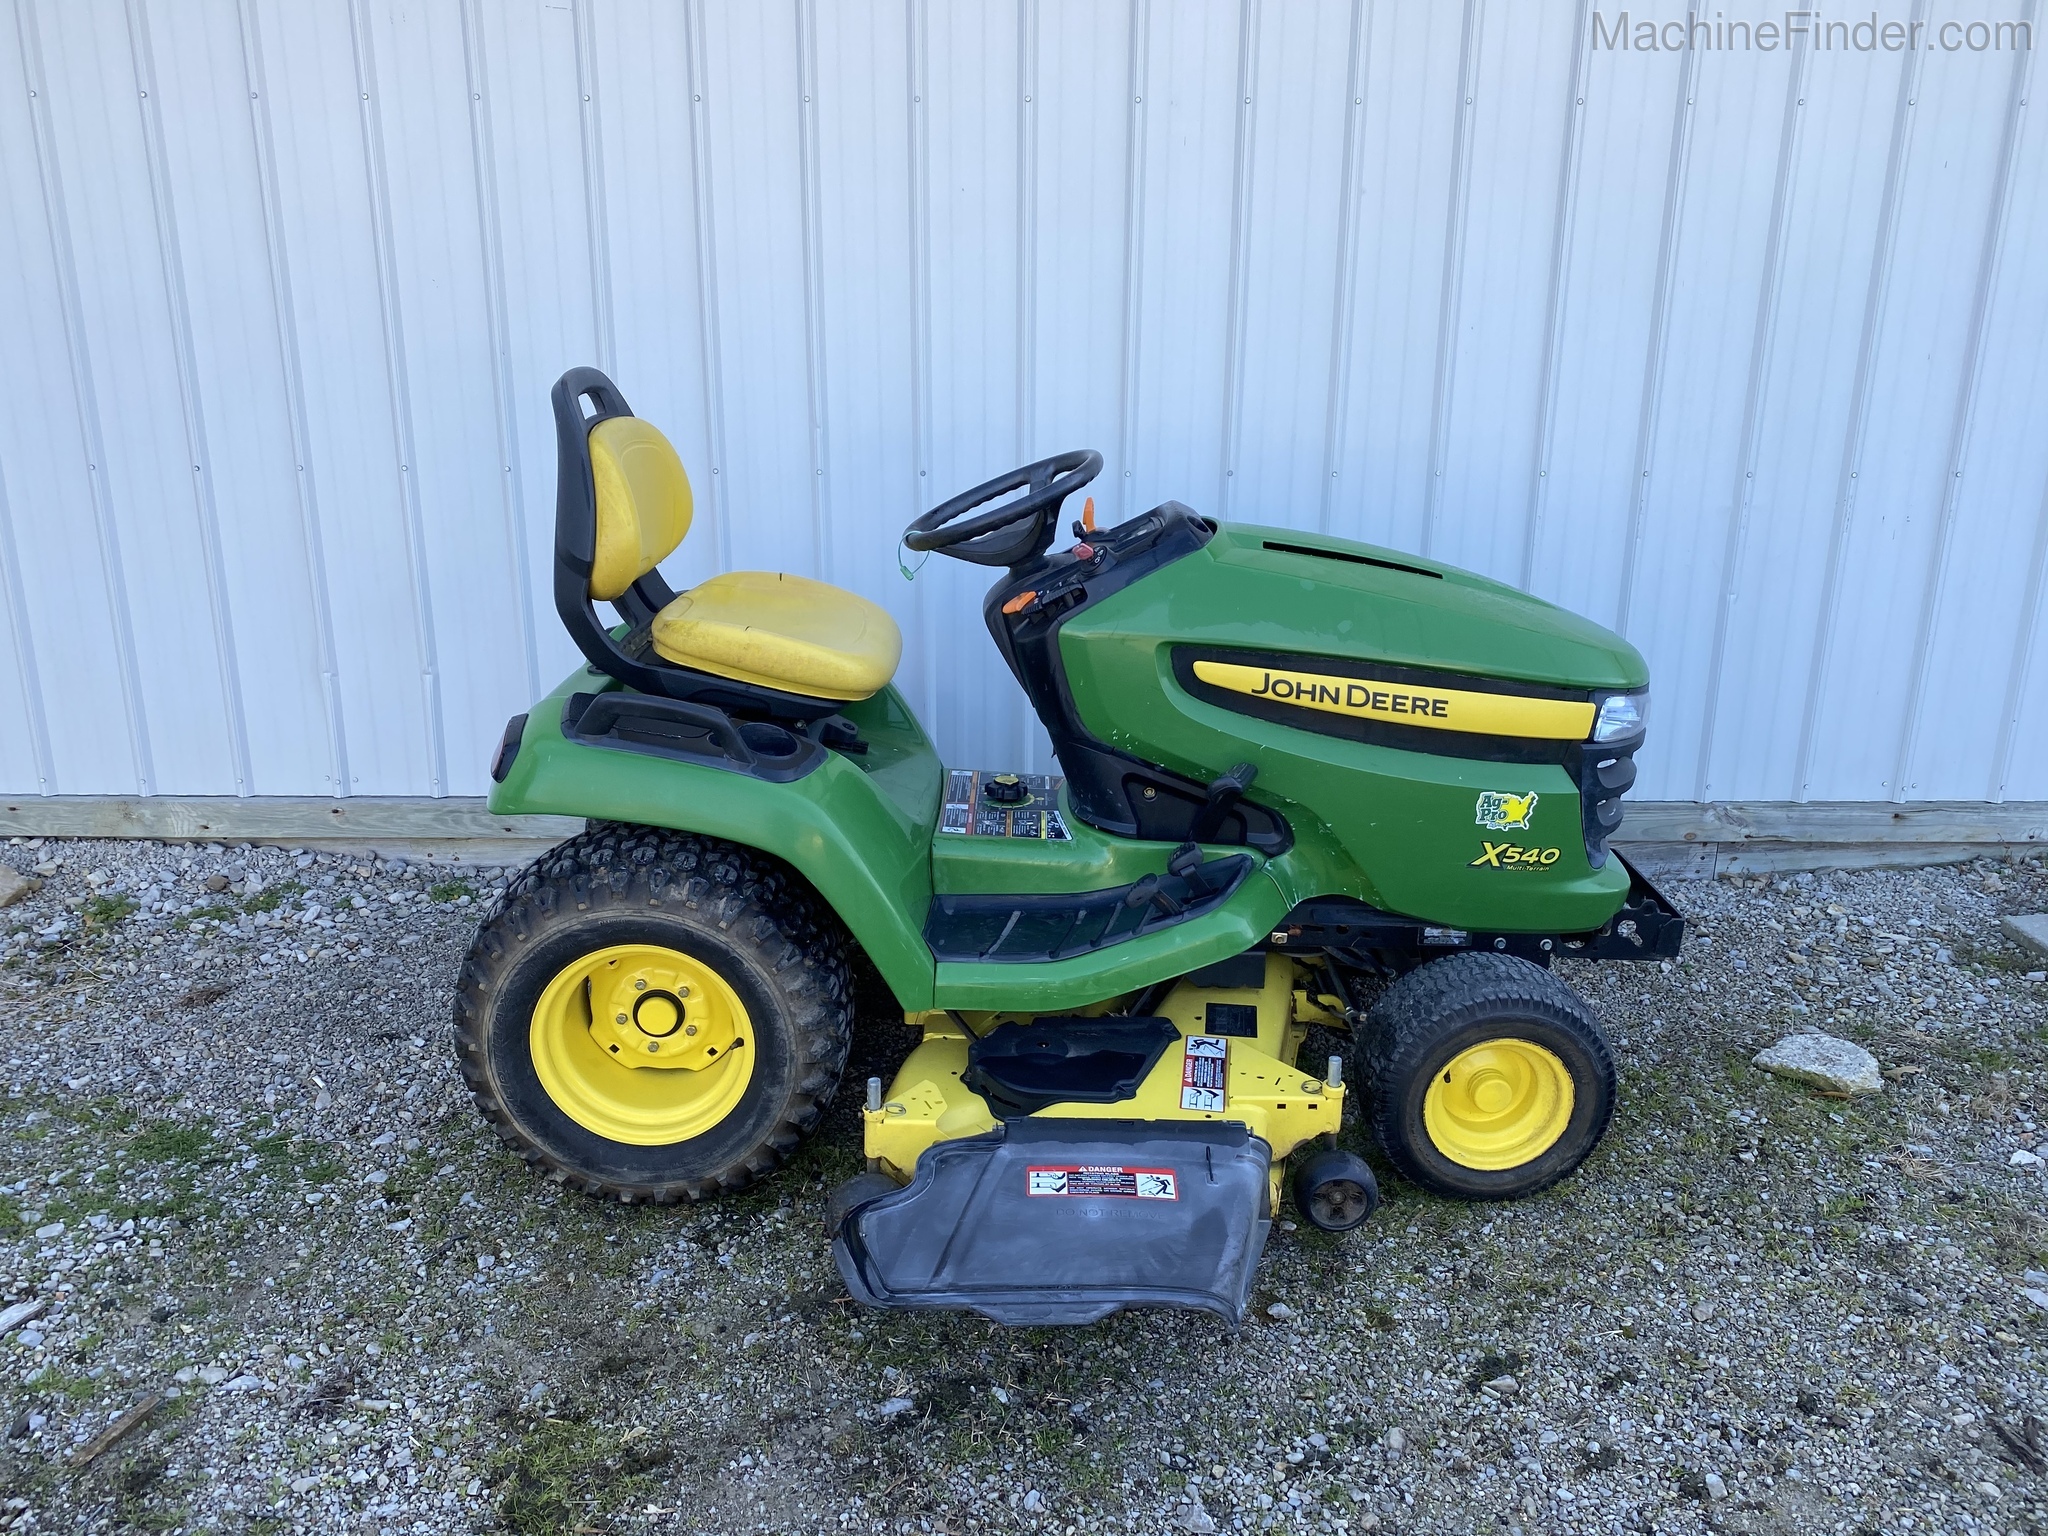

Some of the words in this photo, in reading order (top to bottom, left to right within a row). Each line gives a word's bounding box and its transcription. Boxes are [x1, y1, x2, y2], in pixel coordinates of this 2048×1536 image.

[1251, 673, 1339, 704] JOHN
[1347, 684, 1448, 718] DEERE
[1480, 809, 1508, 820] Pro
[1469, 841, 1561, 868] X540
[1184, 1058, 1193, 1078] DANGER
[1056, 1208, 1075, 1216] DO
[1079, 1208, 1106, 1218] NOT
[1110, 1208, 1166, 1220] REMOVE
